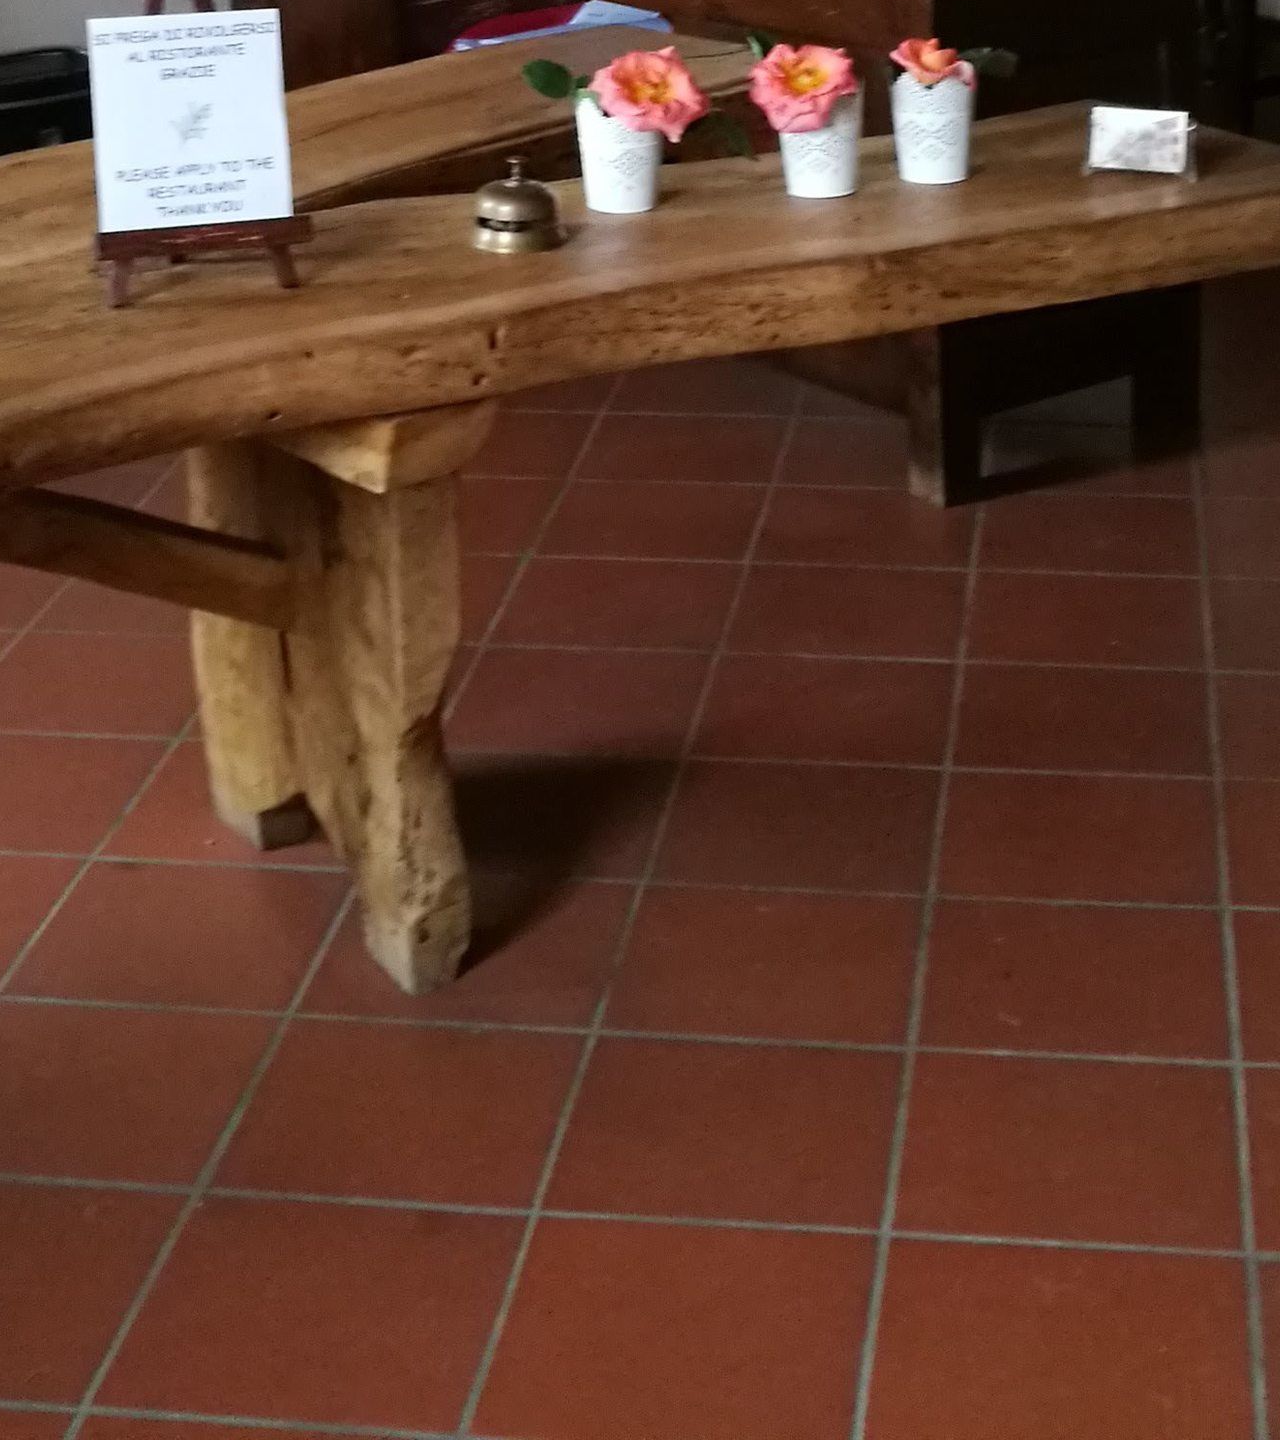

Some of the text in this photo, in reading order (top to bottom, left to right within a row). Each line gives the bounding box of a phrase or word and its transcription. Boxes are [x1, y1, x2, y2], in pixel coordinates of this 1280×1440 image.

[160, 64, 216, 80] GRAZIE
[116, 156, 274, 183] PLEASE APPLY TO THE
[147, 179, 246, 199] RESTAURANT
[156, 200, 244, 217] THANK YOU
